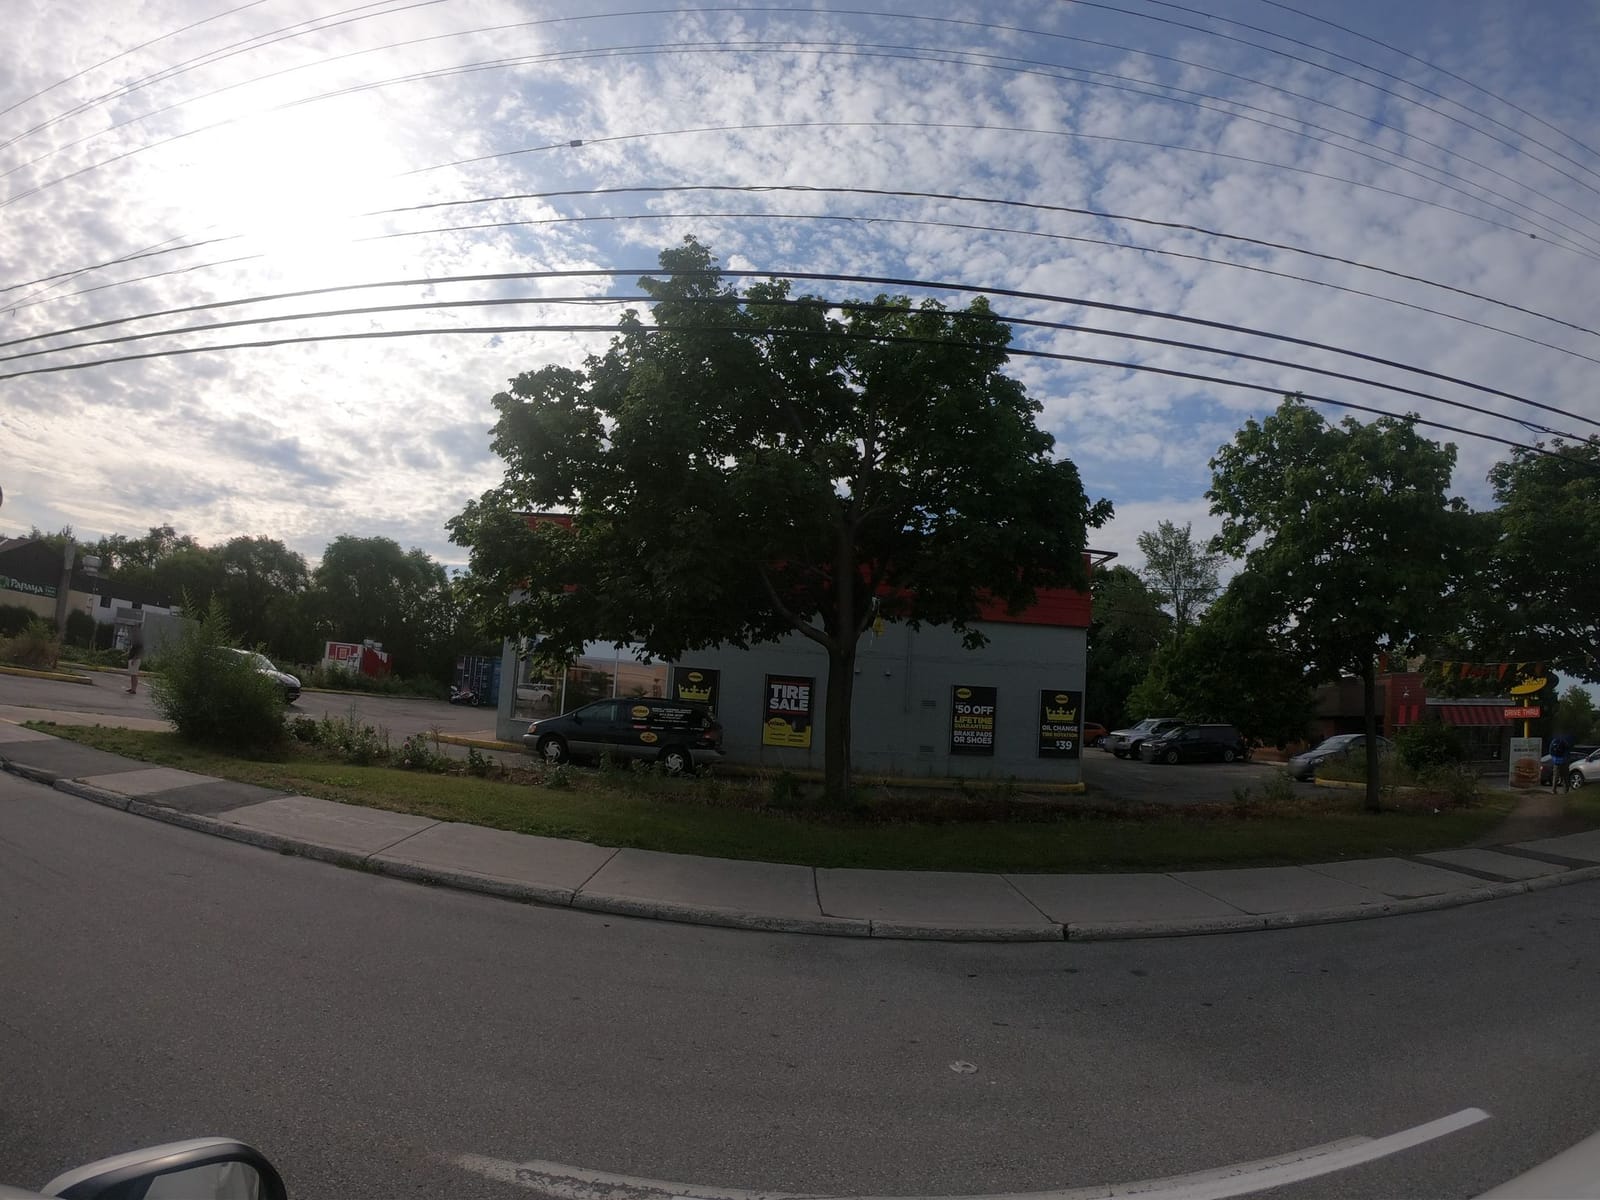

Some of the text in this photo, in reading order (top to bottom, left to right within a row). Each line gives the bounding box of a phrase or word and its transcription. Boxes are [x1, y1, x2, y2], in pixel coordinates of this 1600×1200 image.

[770, 684, 810, 700] TIRE
[770, 698, 808, 712] SALE
[972, 706, 994, 714] OFF
[954, 716, 993, 724] LIFETIME
[1056, 740, 1072, 750] $39
